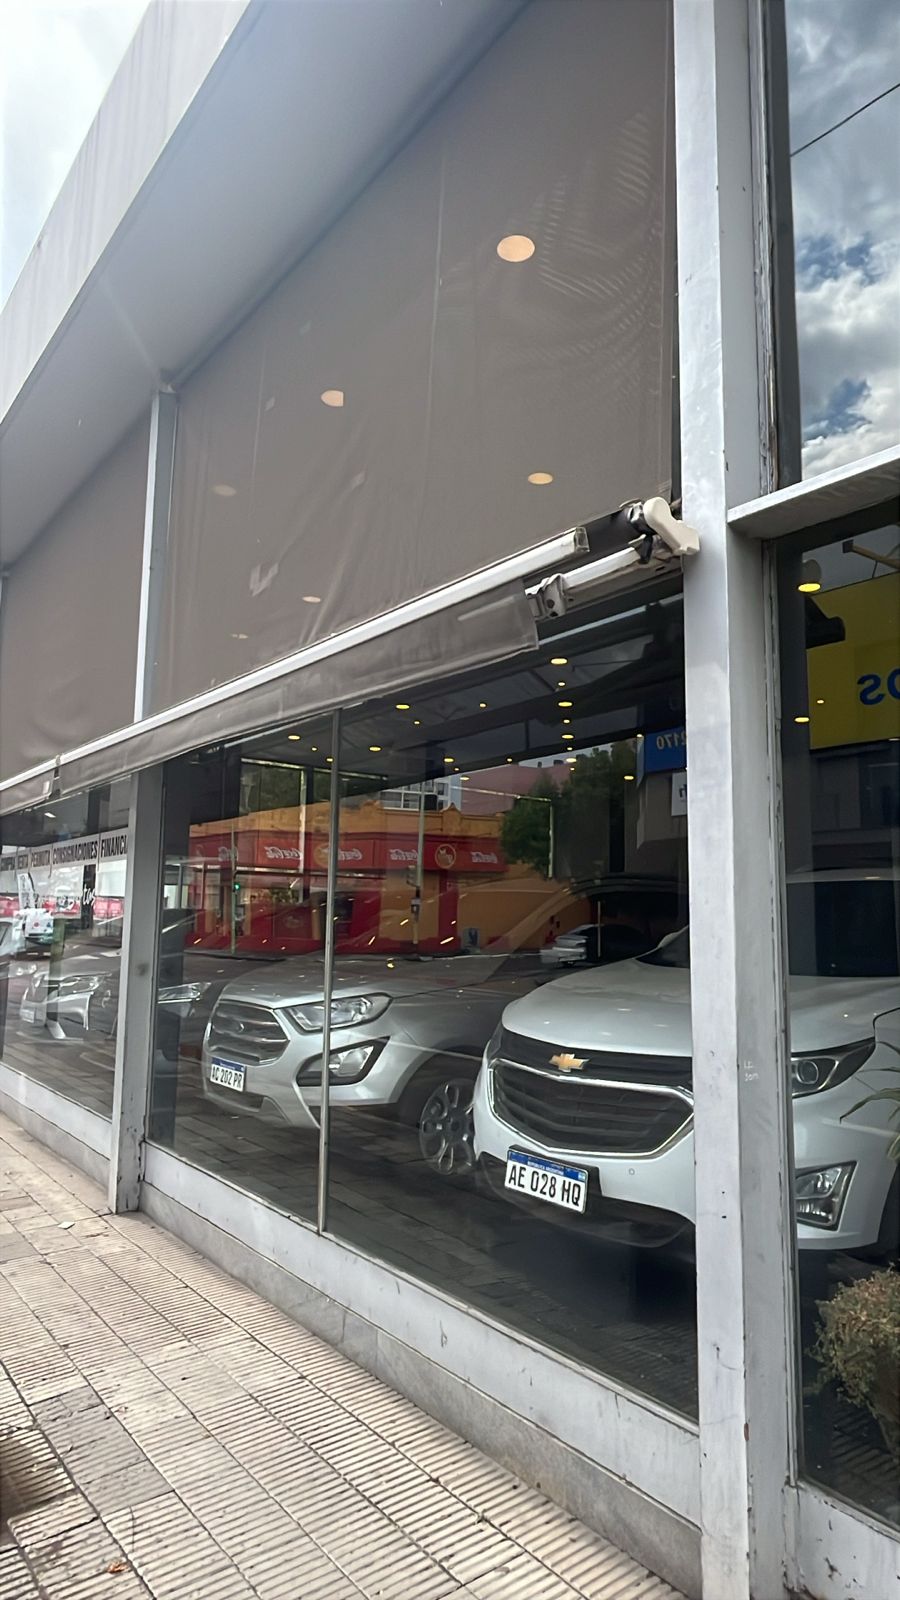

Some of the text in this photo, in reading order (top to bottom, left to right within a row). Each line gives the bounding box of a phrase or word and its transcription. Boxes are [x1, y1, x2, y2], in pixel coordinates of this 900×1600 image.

[101, 835, 127, 857] FINANCI
[508, 1164, 581, 1206] AE 028 HQ
